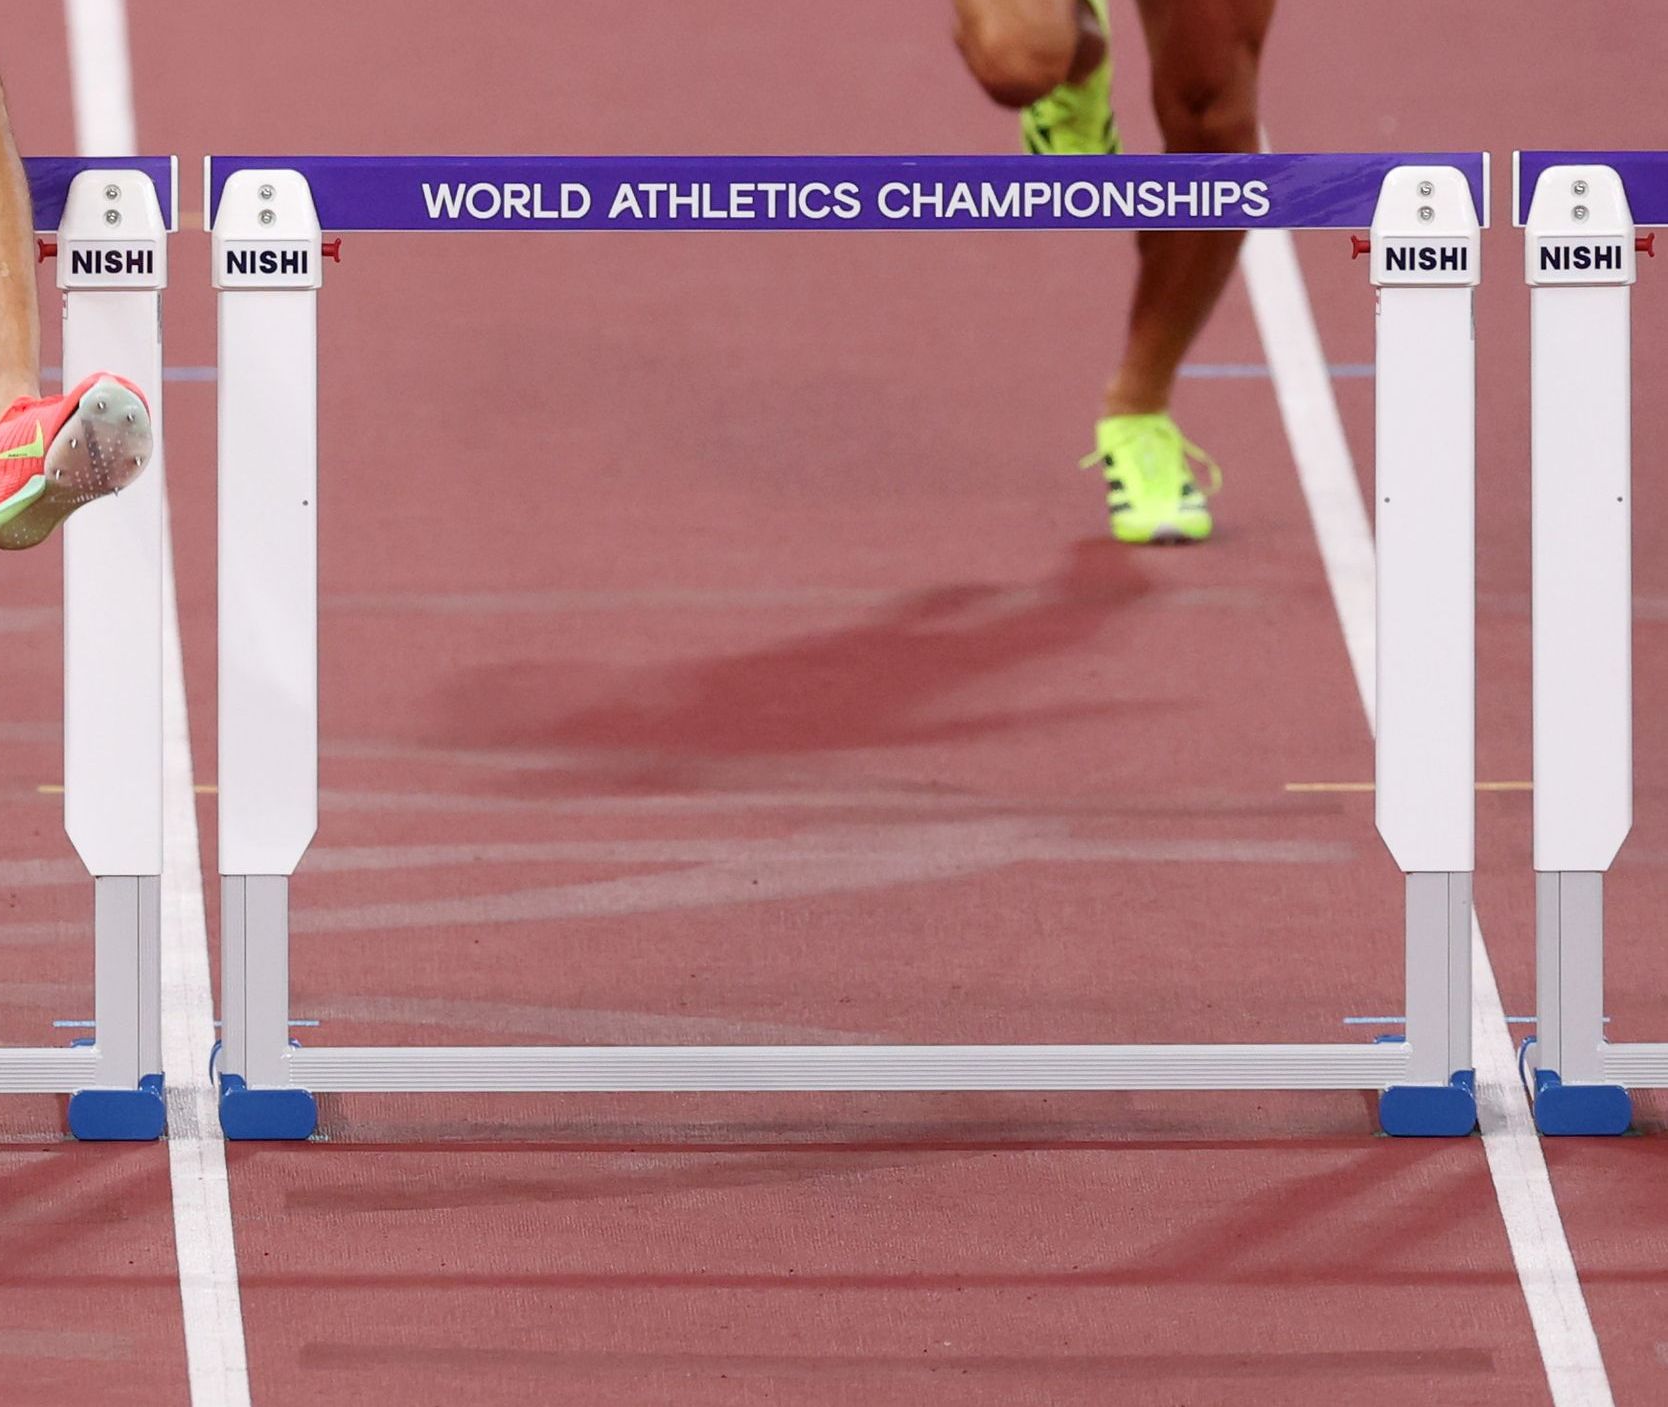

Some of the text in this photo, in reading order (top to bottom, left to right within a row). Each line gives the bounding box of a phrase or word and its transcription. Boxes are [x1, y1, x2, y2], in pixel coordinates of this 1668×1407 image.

[422, 180, 1271, 219] WORLD ATHLETICS CHAMPIONSHIPS
[71, 250, 154, 275] NISHI
[226, 250, 308, 275] NISHI
[1385, 246, 1467, 272] NISHI
[1540, 245, 1622, 271] NISHI
